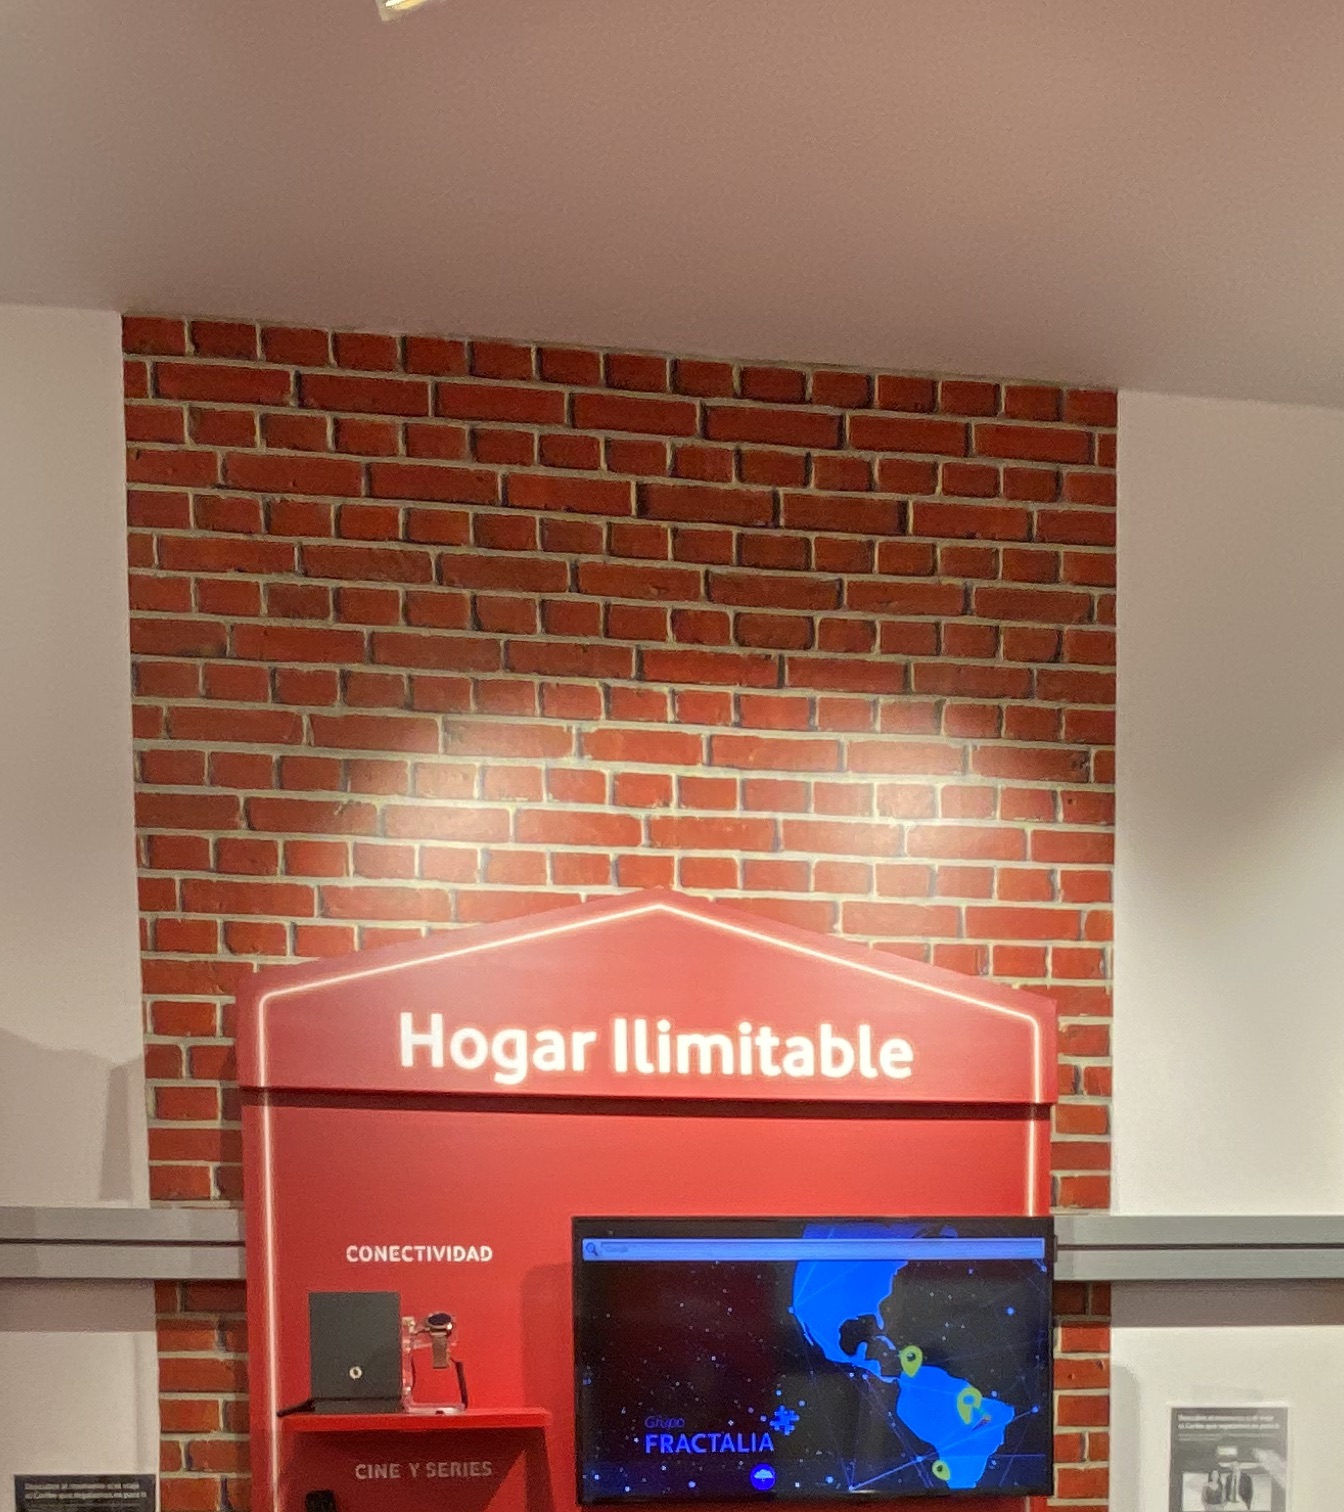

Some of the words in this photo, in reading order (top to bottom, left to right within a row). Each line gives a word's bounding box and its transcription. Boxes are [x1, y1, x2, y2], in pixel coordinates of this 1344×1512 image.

[399, 1011, 596, 1085] Hogar
[613, 1017, 914, 1079] Ilimitable
[346, 1245, 493, 1263] CONECTIVIDAD
[644, 1432, 775, 1454] FRACTALIA
[355, 1463, 400, 1480] CINE
[409, 1463, 420, 1478] Y
[426, 1461, 493, 1478] SERIES
